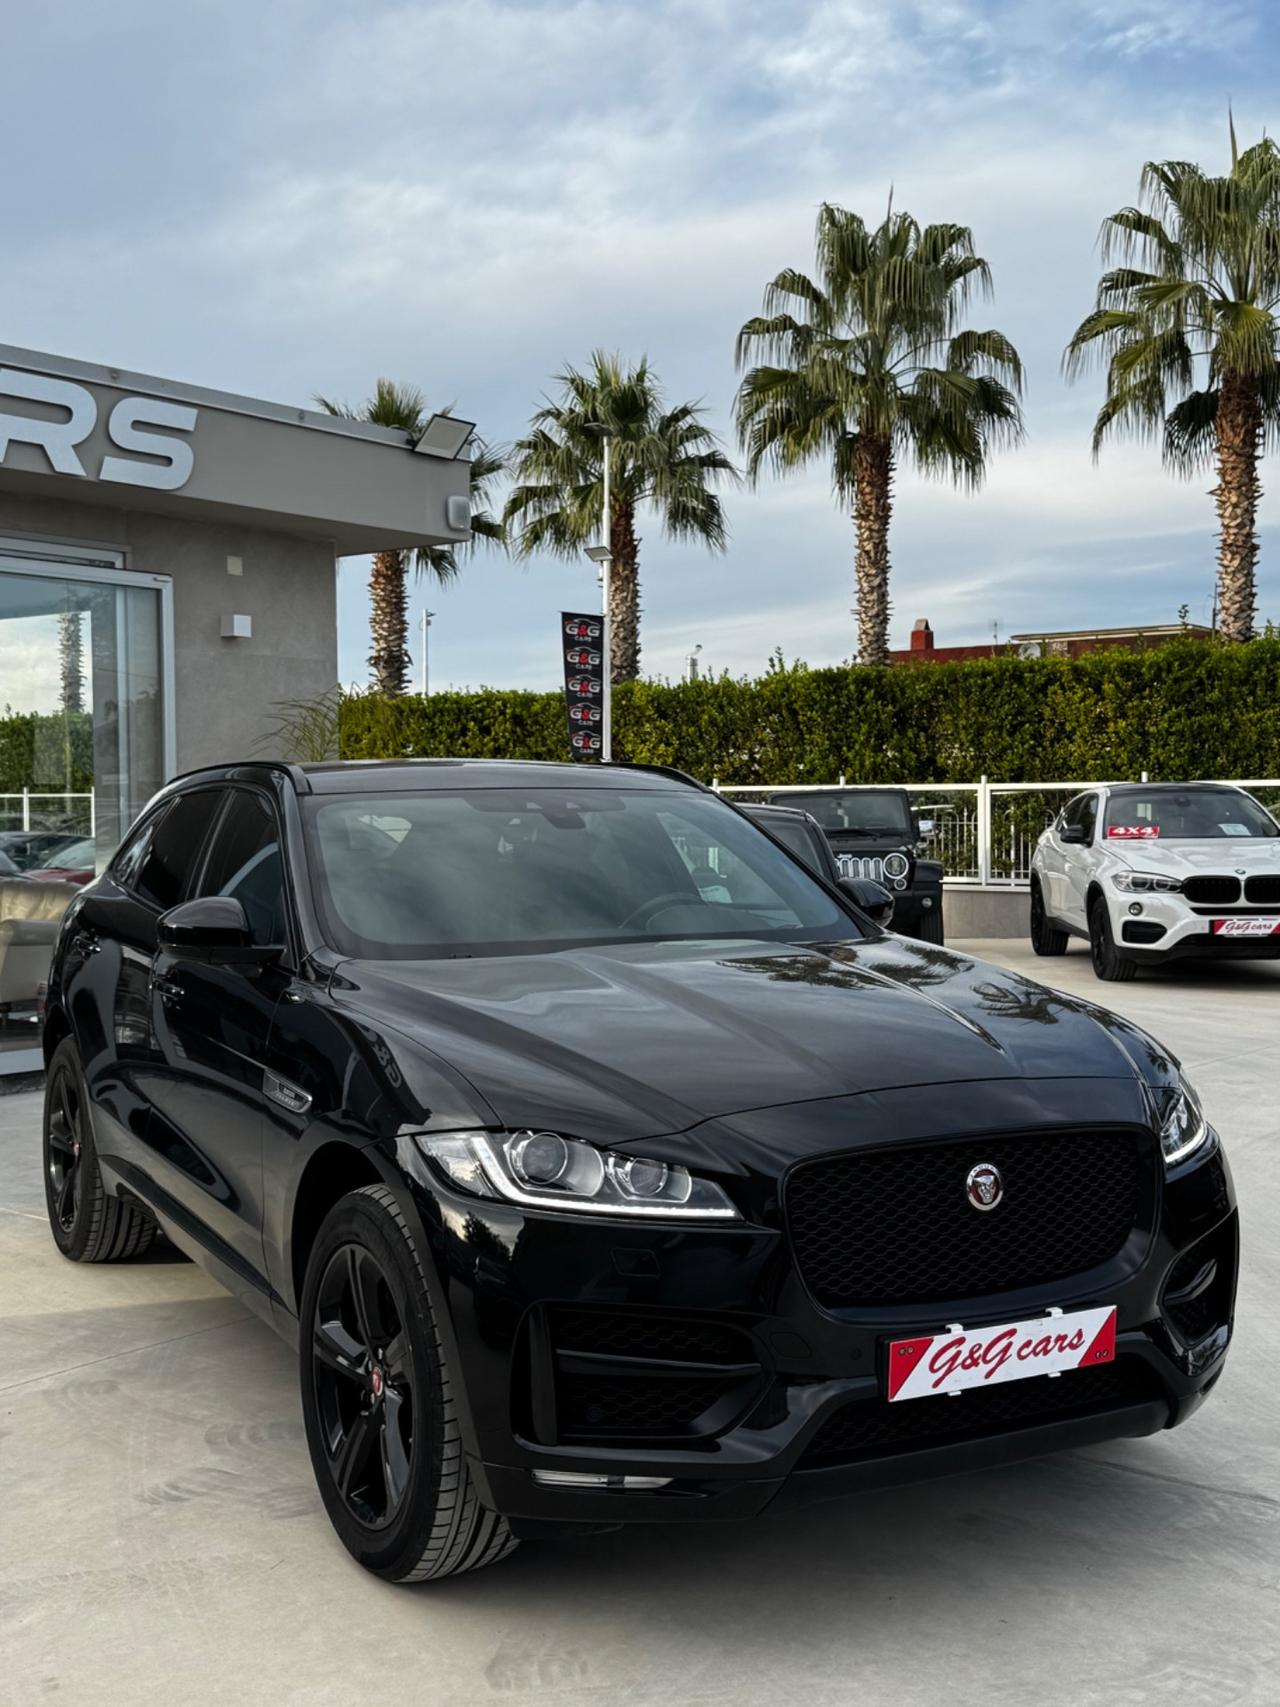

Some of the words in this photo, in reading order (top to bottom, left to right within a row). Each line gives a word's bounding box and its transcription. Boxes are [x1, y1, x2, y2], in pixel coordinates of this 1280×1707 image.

[566, 623, 600, 637] G&G
[567, 651, 600, 665] G&G
[568, 679, 600, 693] G&G
[570, 708, 601, 720] G&G
[572, 735, 600, 749] G&G
[1016, 1328, 1085, 1362] cars
